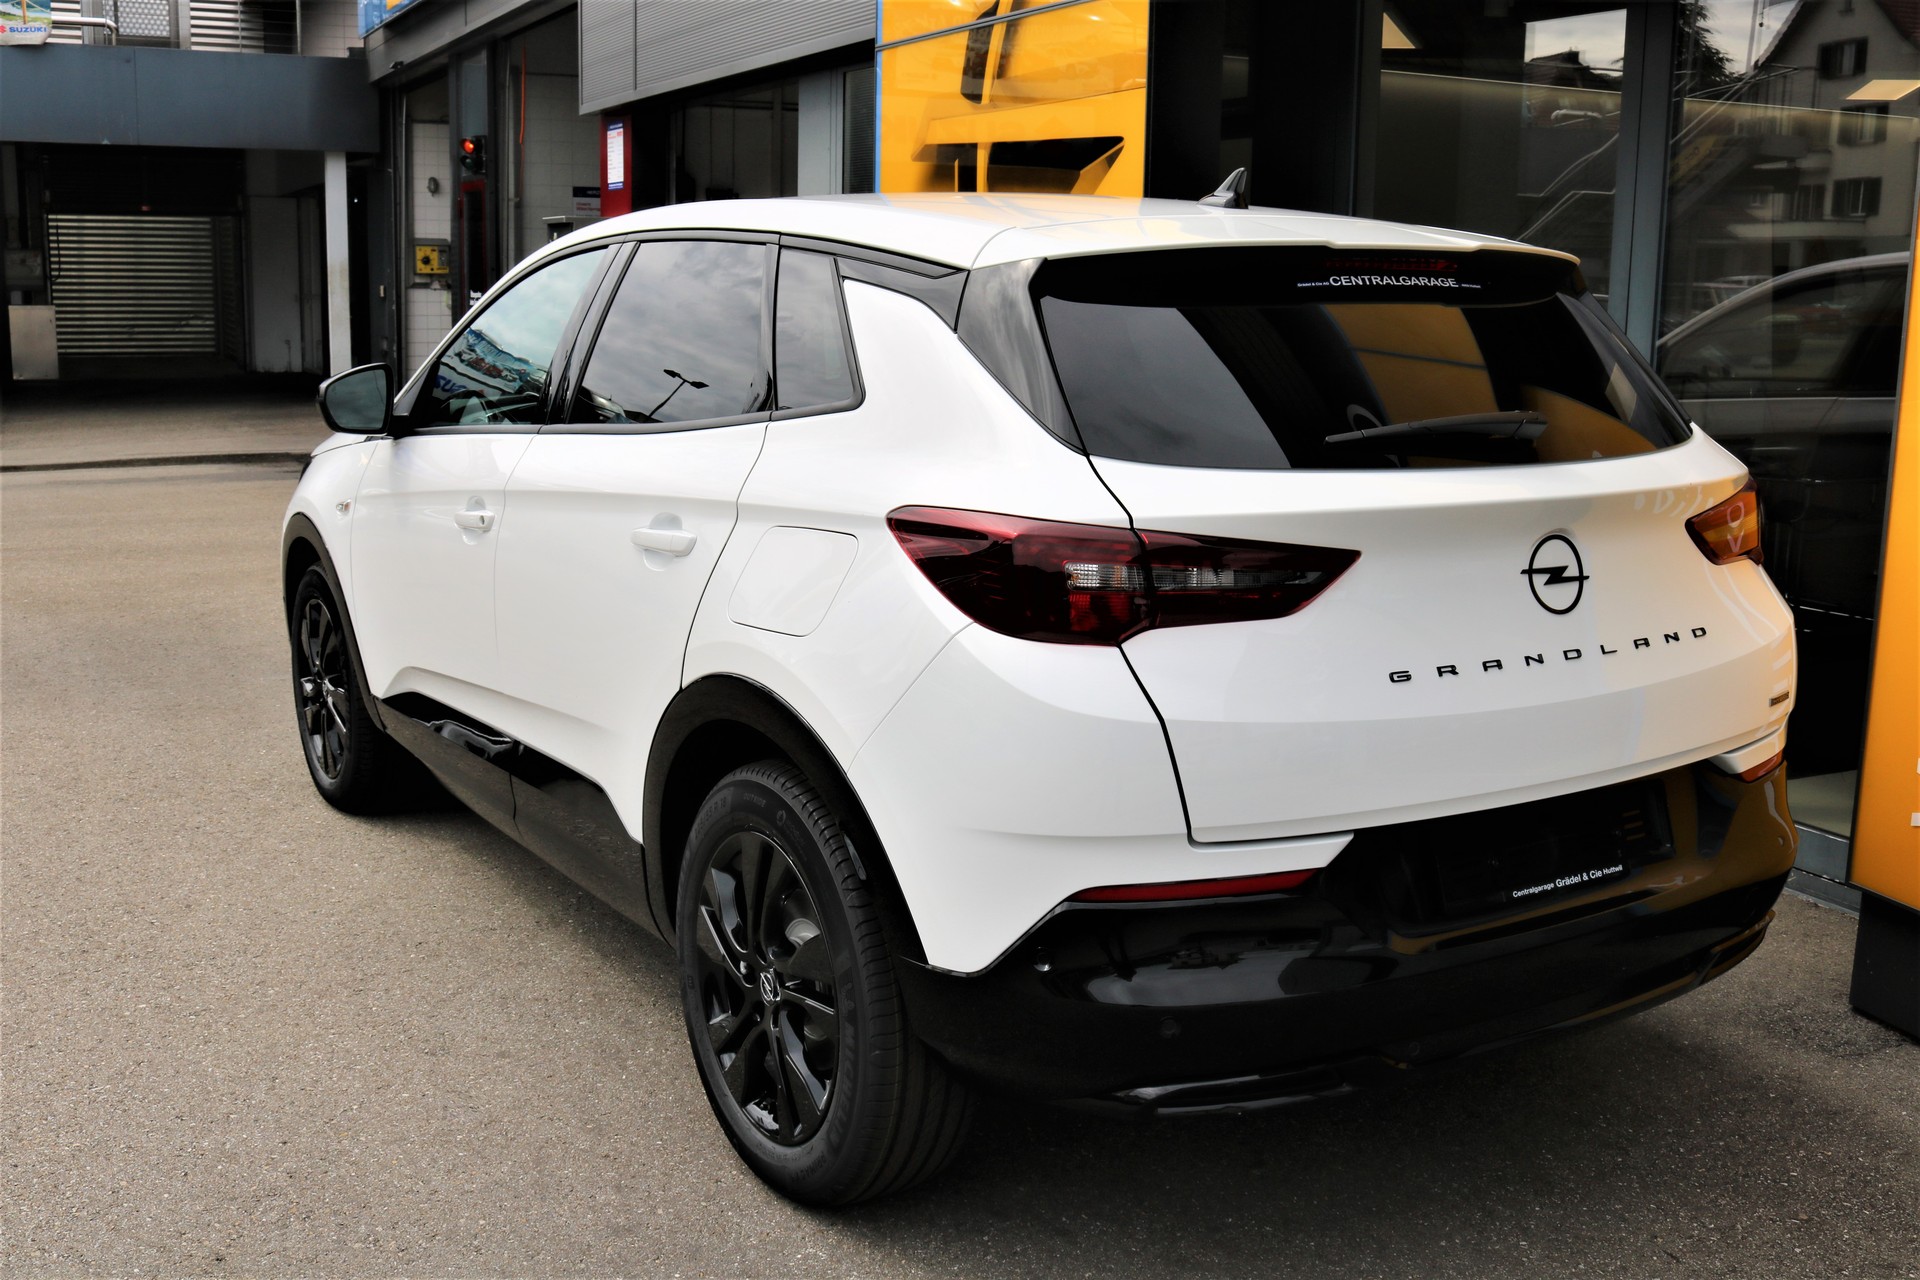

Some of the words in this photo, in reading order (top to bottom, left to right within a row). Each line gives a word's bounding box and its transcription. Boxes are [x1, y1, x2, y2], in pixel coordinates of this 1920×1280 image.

[1329, 275, 1458, 288] CENTRALGARAGE
[1389, 627, 1707, 683] GRANDLAND
[1512, 882, 1555, 898] Centralgarage
[1555, 873, 1582, 887] Grädel
[1582, 872, 1589, 881] &
[1589, 869, 1602, 879] Cie
[1602, 864, 1623, 875] Huttwil
